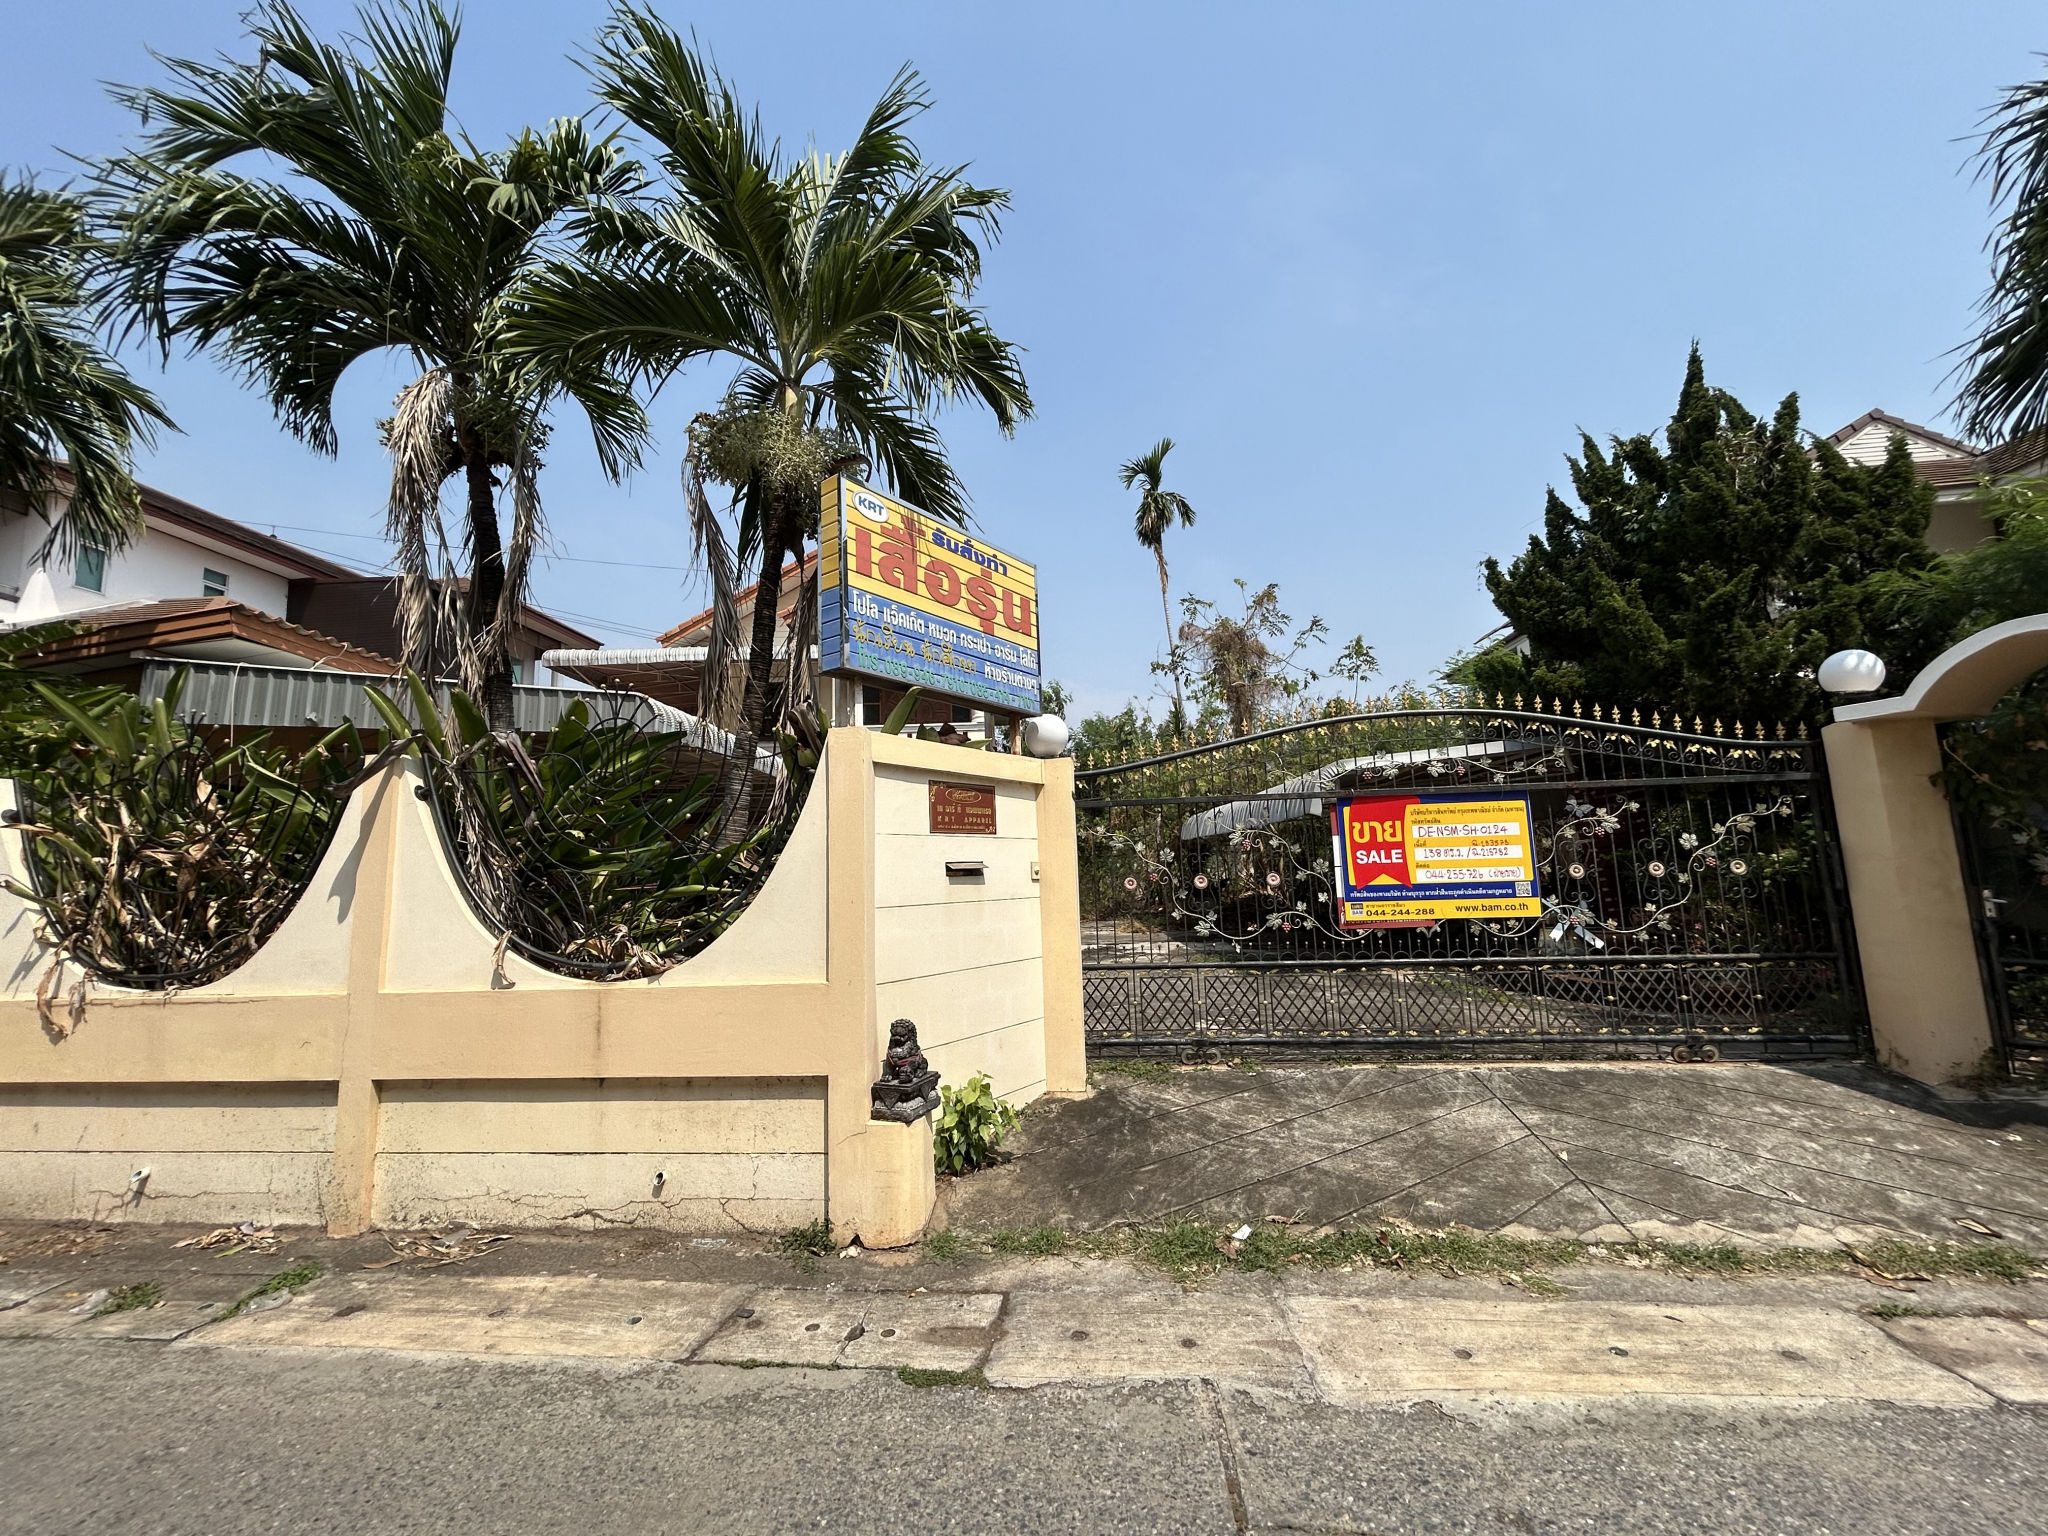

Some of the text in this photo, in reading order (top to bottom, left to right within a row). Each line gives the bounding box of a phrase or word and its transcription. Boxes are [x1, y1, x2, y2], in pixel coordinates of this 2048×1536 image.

[858, 495, 884, 516] KRT
[931, 527, 1008, 577] รับสั่งทำ
[855, 515, 1032, 636] เสื้อรุ่น
[852, 590, 879, 620] โปโล
[883, 604, 925, 635] แจ็คเก็ต
[928, 622, 957, 645] หมวก
[994, 644, 1018, 664] อาร์ม
[1020, 647, 1037, 670] โลโก้
[852, 619, 915, 658] นักเรียน
[921, 638, 977, 675] นักศึกษา
[1352, 820, 1403, 844] ขาย
[1356, 849, 1404, 864] SALE
[1366, 903, 1529, 917] 044-244-288 www.bam.co.th
